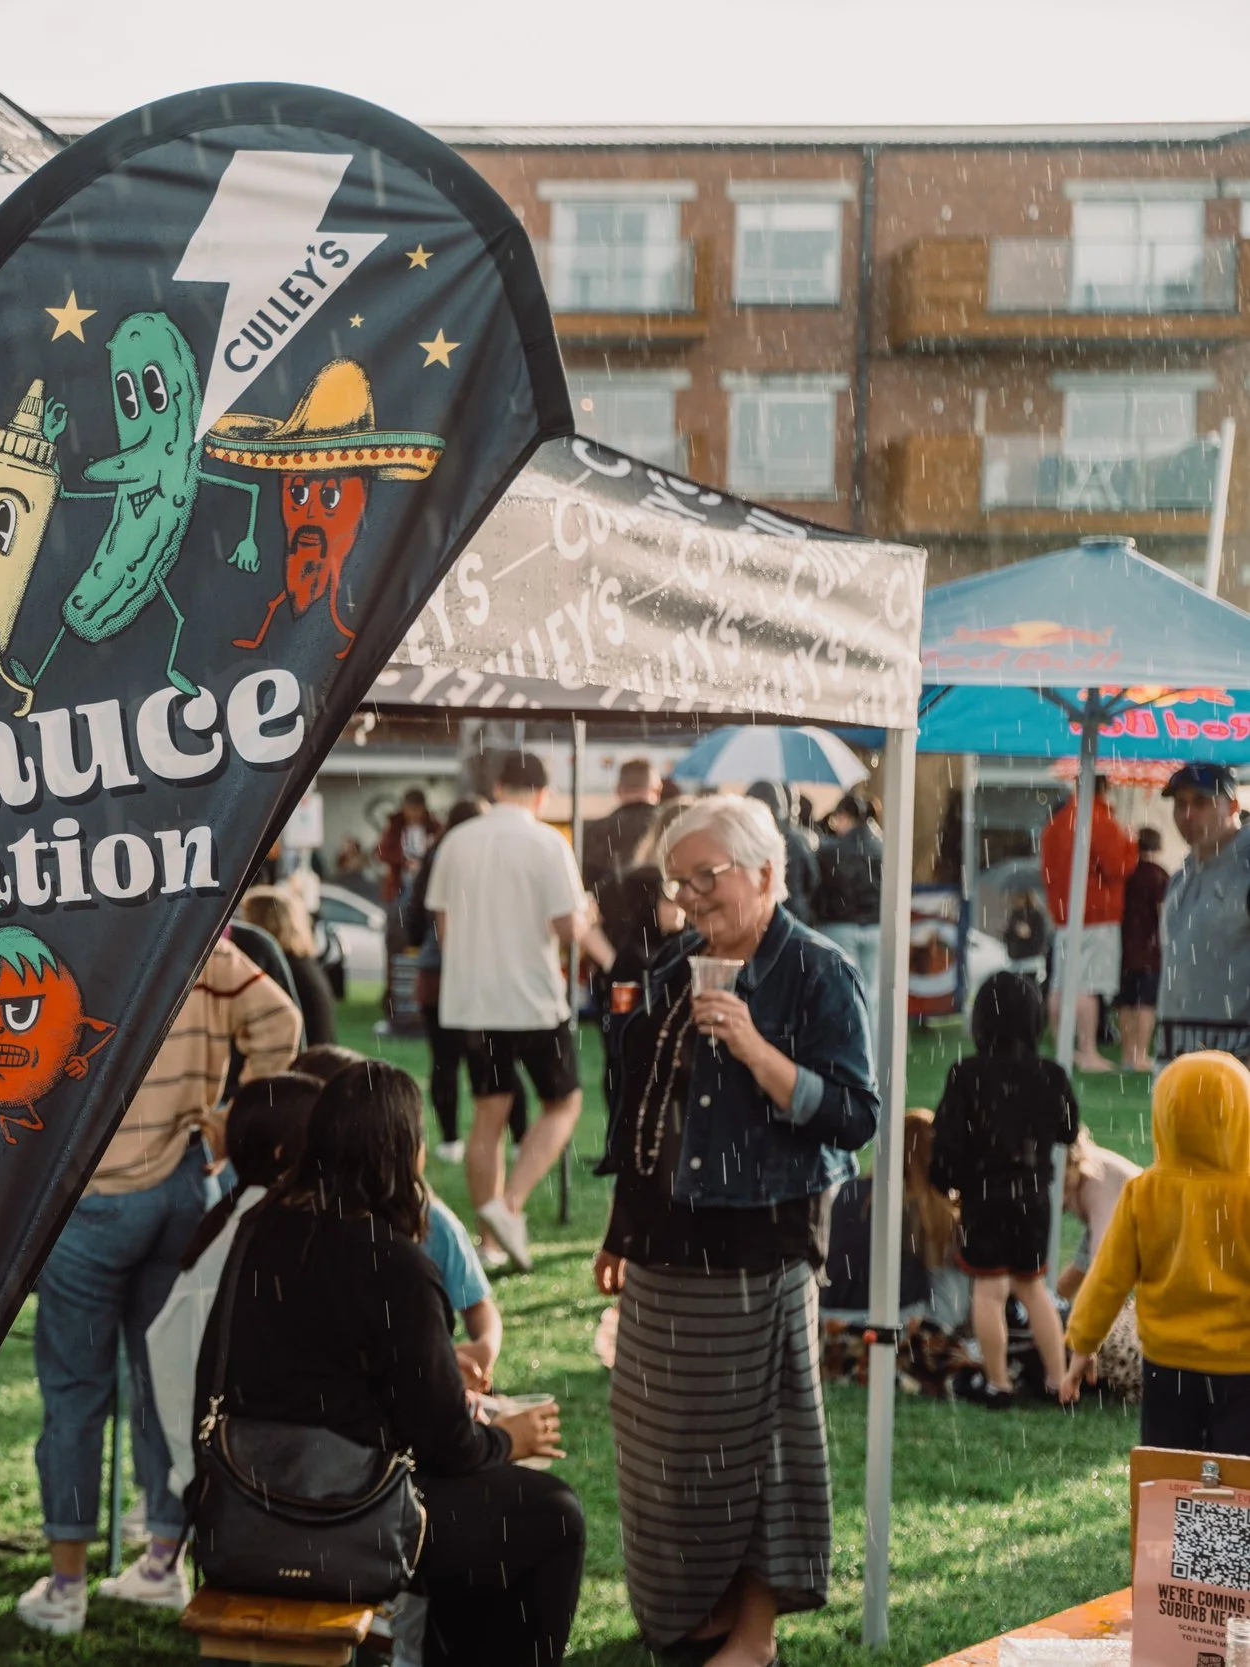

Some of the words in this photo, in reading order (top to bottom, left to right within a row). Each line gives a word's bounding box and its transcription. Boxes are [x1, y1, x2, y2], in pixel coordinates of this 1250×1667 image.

[224, 240, 350, 373] CULLEY'S
[1158, 1583, 1195, 1604] WE'RE
[1197, 1591, 1246, 1614] COMING
[1158, 1600, 1207, 1623] SUBURB
[1210, 1608, 1242, 1628] NE
[1178, 1624, 1198, 1633] SCAN
[1199, 1628, 1213, 1636] THE
[1182, 1633, 1192, 1641] TO
[1193, 1636, 1218, 1647] LEARN
